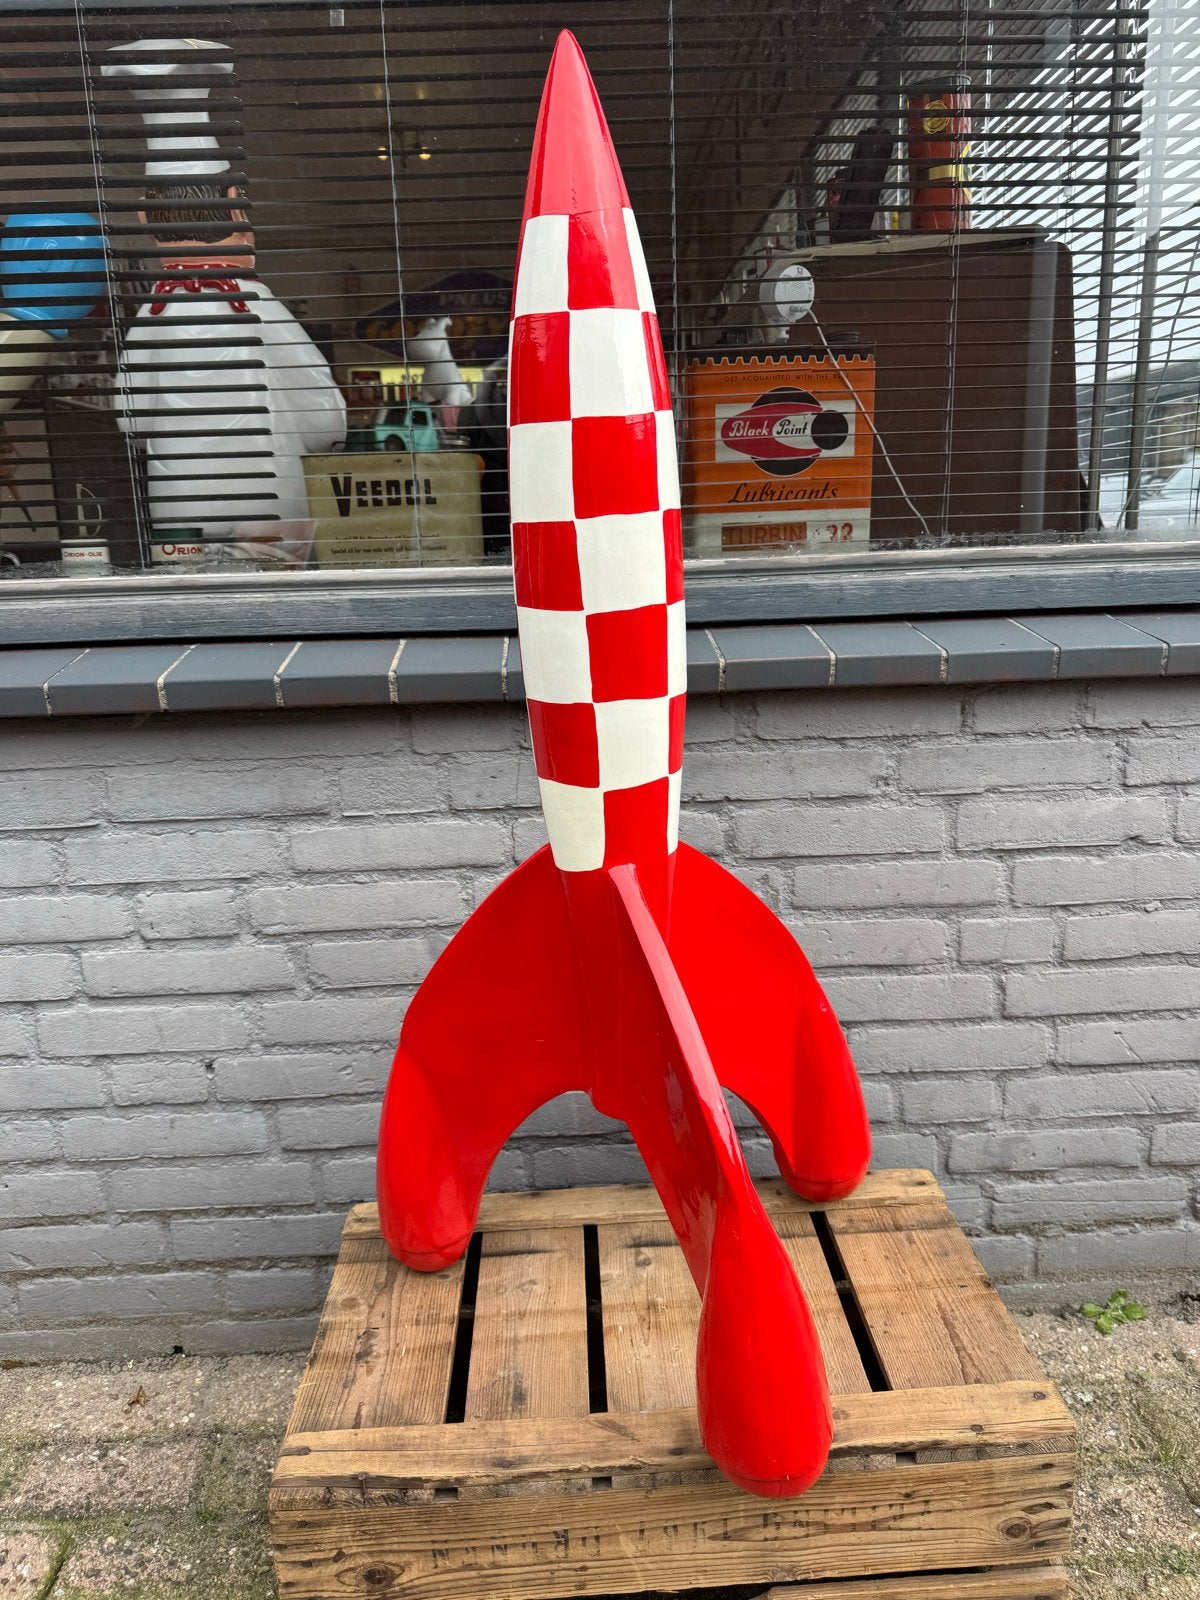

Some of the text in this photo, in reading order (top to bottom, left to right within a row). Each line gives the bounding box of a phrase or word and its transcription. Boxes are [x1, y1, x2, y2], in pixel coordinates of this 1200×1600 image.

[438, 293, 508, 306] PNEUS
[724, 372, 850, 383] GET ACQUAINTED WITH THE BET
[728, 419, 808, 437] Black Point
[327, 472, 438, 517] VEEDOL
[728, 481, 839, 504] Lubricants
[162, 543, 203, 556] ORION
